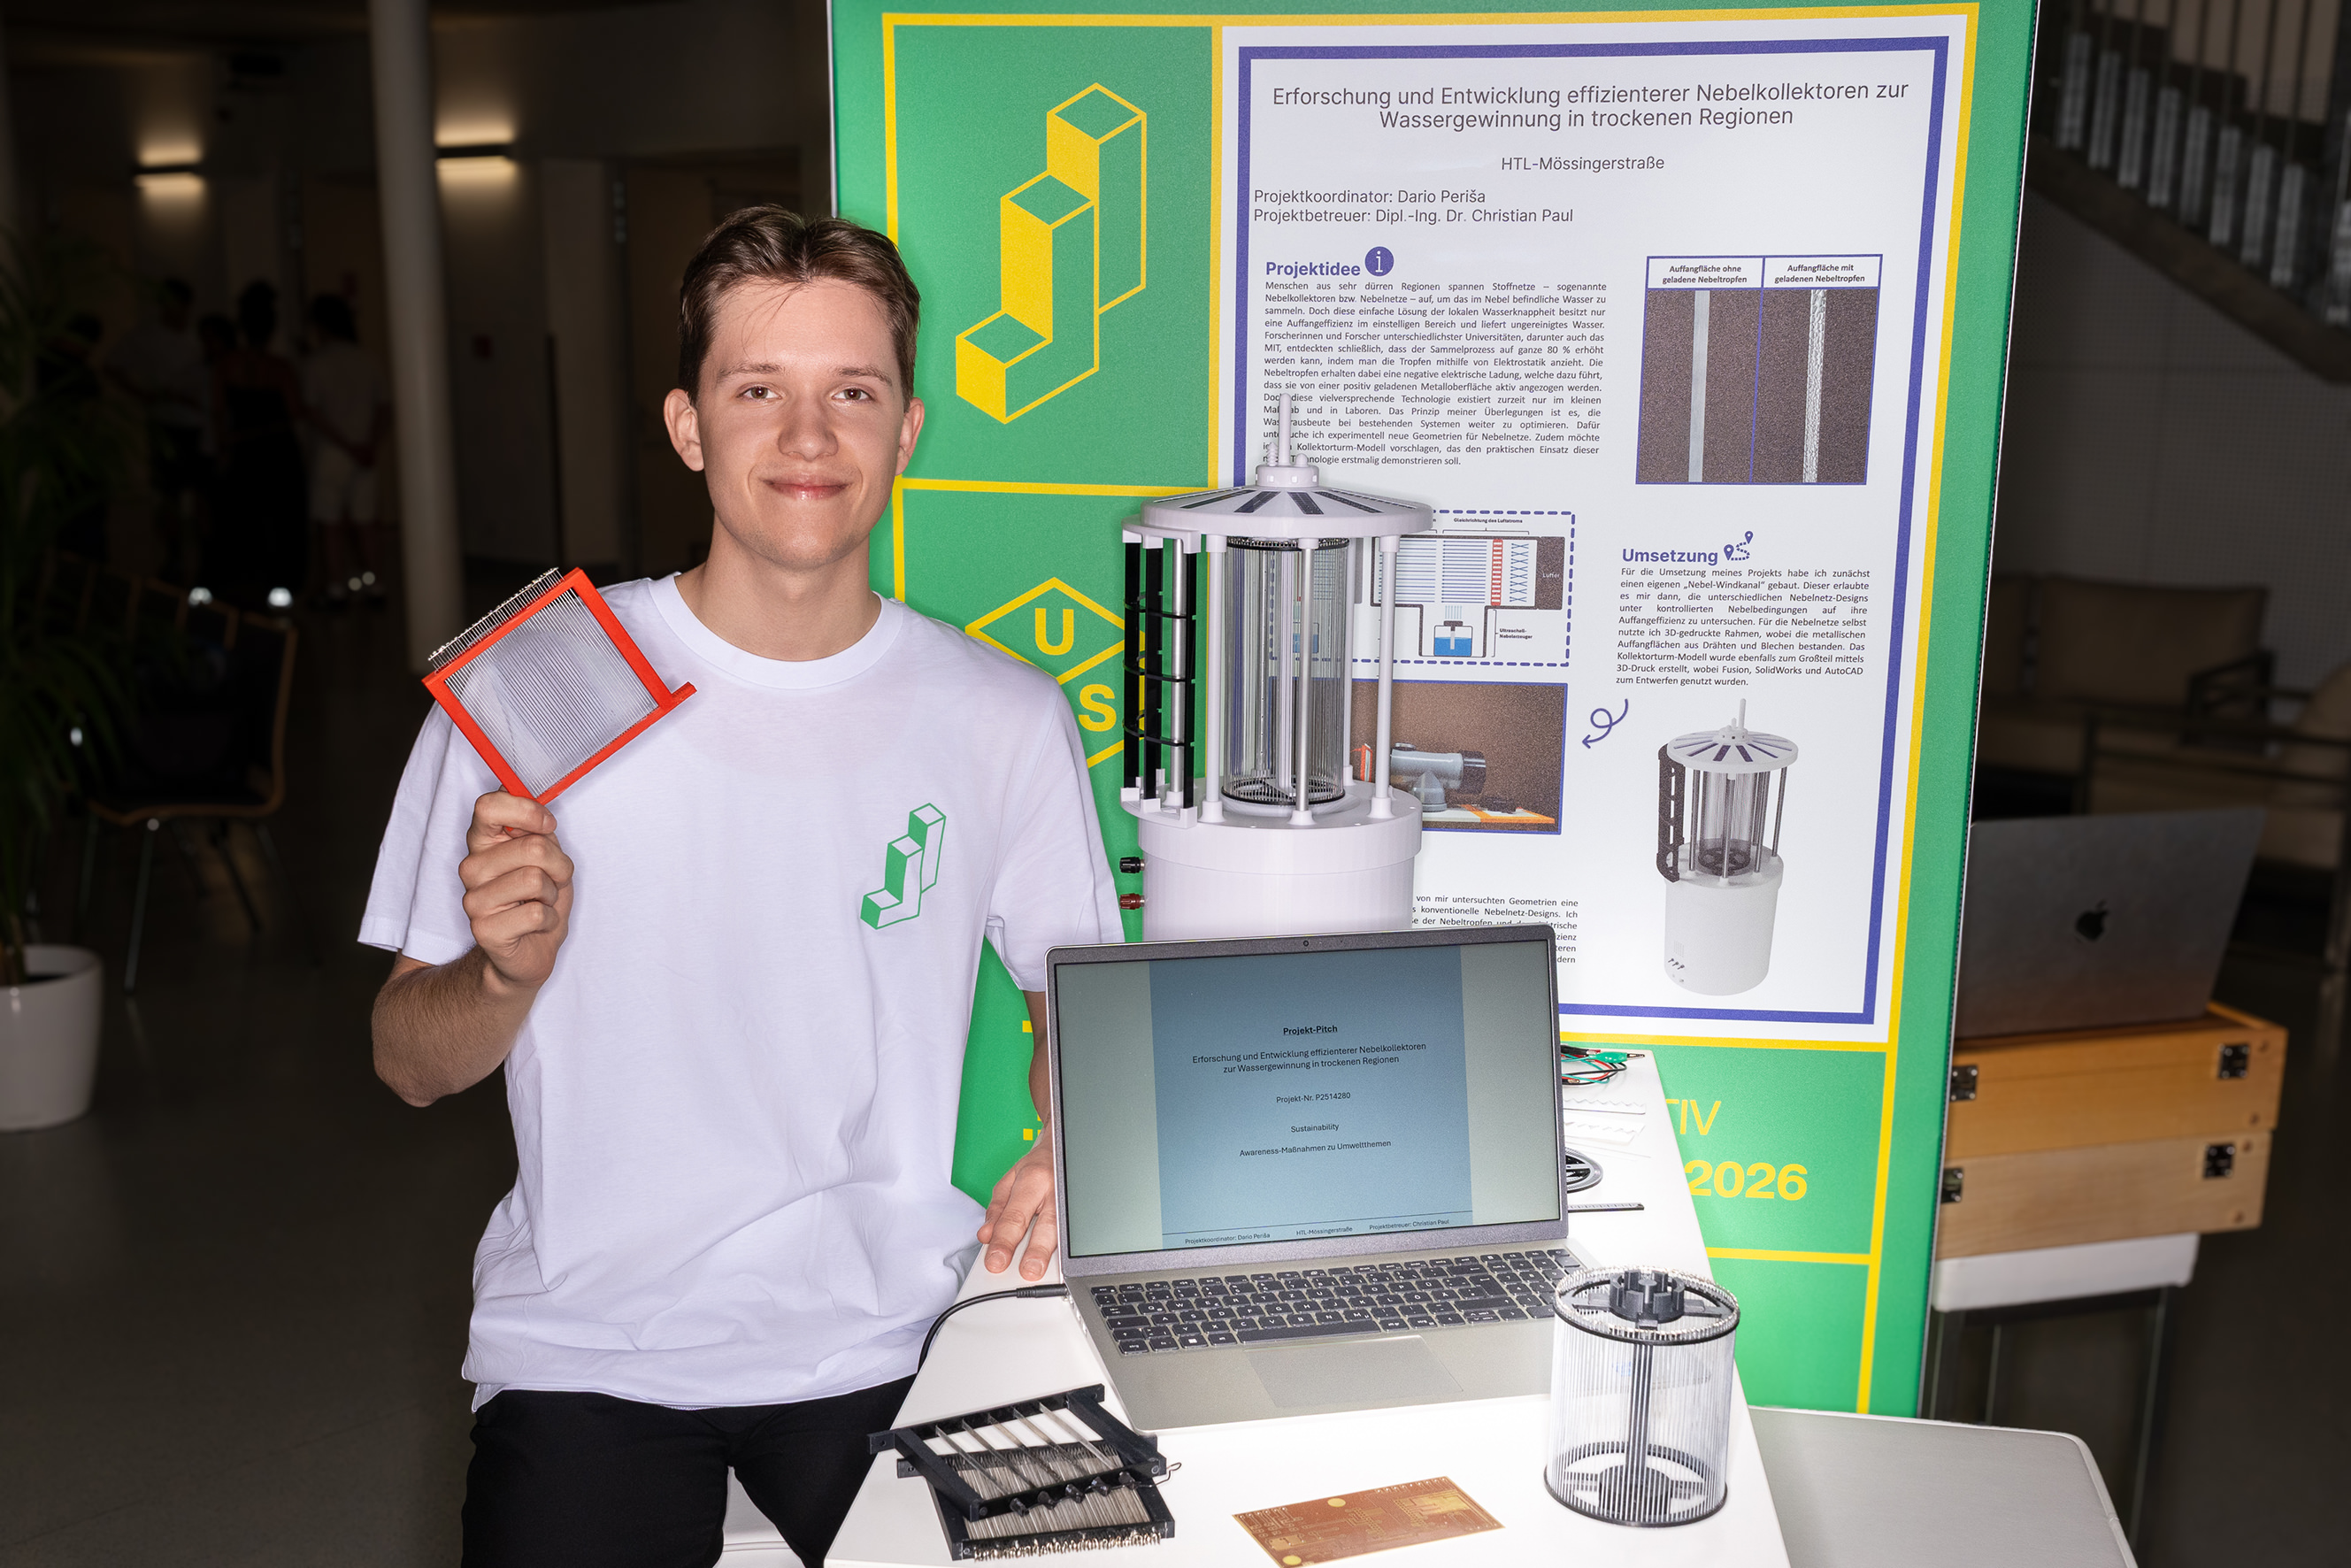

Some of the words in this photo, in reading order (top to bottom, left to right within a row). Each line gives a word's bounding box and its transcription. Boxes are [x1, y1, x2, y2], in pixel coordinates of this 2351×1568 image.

[1273, 87, 1390, 108] Erforschung
[1398, 87, 1433, 104] und
[1441, 87, 1560, 107] Entwicklung
[1567, 85, 1690, 102] effizienterer
[1696, 83, 1868, 100] Nebelkollektoren
[1875, 84, 1909, 97] zur
[1379, 111, 1561, 131] Wassergewinnung
[1568, 109, 1584, 126] in
[1591, 110, 1691, 126] trockenen
[1699, 108, 1792, 128] Regionen
[1501, 156, 1664, 172] HTL-Mössingerstraße
[1254, 190, 1392, 204] Projektkoordinator:
[1398, 190, 1436, 202] Dario
[1441, 189, 1485, 202] Periša
[1254, 209, 1370, 223] Projektbetreuer:
[1376, 209, 1440, 224] Dipl.-Ing.
[1446, 209, 1466, 221] Dr.
[1471, 209, 1536, 221] Christian
[1542, 209, 1573, 221] Paul
[1266, 261, 1360, 278] Projektidee
[1669, 265, 1721, 273] Auffangfläche
[1786, 264, 1839, 272] Auffangfläche
[1662, 276, 1696, 284] geladene
[1774, 275, 1813, 283] geladenen
[1401, 282, 1440, 291] Regionen
[1492, 282, 1535, 290] Stoffnetze
[1556, 283, 1606, 292] sogenannte
[1360, 294, 1407, 302] Nebelnetze
[1418, 294, 1434, 304] auf,
[1512, 295, 1559, 303] befindliche
[1333, 307, 1355, 315] diese
[1358, 307, 1394, 315] einfache
[1397, 307, 1427, 317] Lösung
[1482, 307, 1555, 317] Wasserknappheit
[1622, 549, 1718, 565] Umsetzung
[1659, 568, 1706, 577] Umsetzung
[1747, 569, 1782, 578] Projekts
[1647, 580, 1680, 589] eigenen
[1767, 581, 1799, 590] gebaut.
[1657, 592, 1681, 601] dann,
[1789, 593, 1868, 603] Nebelnetz-Designs
[1728, 605, 1807, 615] Nebelbedingungen
[1618, 616, 1685, 625] Auffangeffizienz
[1035, 608, 1074, 656] U
[1078, 684, 1116, 732] S
[1508, 897, 1557, 905] Geometrien
[1420, 906, 1479, 914] konventionelle
[1484, 908, 1560, 918] Nebelnetz-Designs.
[1283, 1025, 1337, 1035] Projekt-Pitch
[1192, 1054, 1241, 1063] Erforschung
[1260, 1050, 1309, 1059] Entwicklung
[1359, 1044, 1426, 1053] Nebelkollektoren
[1236, 1061, 1311, 1071] Wassergewinnung
[1362, 1056, 1399, 1065] Regionen
[1276, 1095, 1314, 1103] Projekt-Nr.
[1315, 1092, 1351, 1100] P2514280
[1290, 1123, 1339, 1132] Sustainability
[1239, 1145, 1326, 1156] Awareness-Maßnahmen
[1336, 1141, 1391, 1149] Umweltthemen
[1684, 1160, 1807, 1201] 2026
